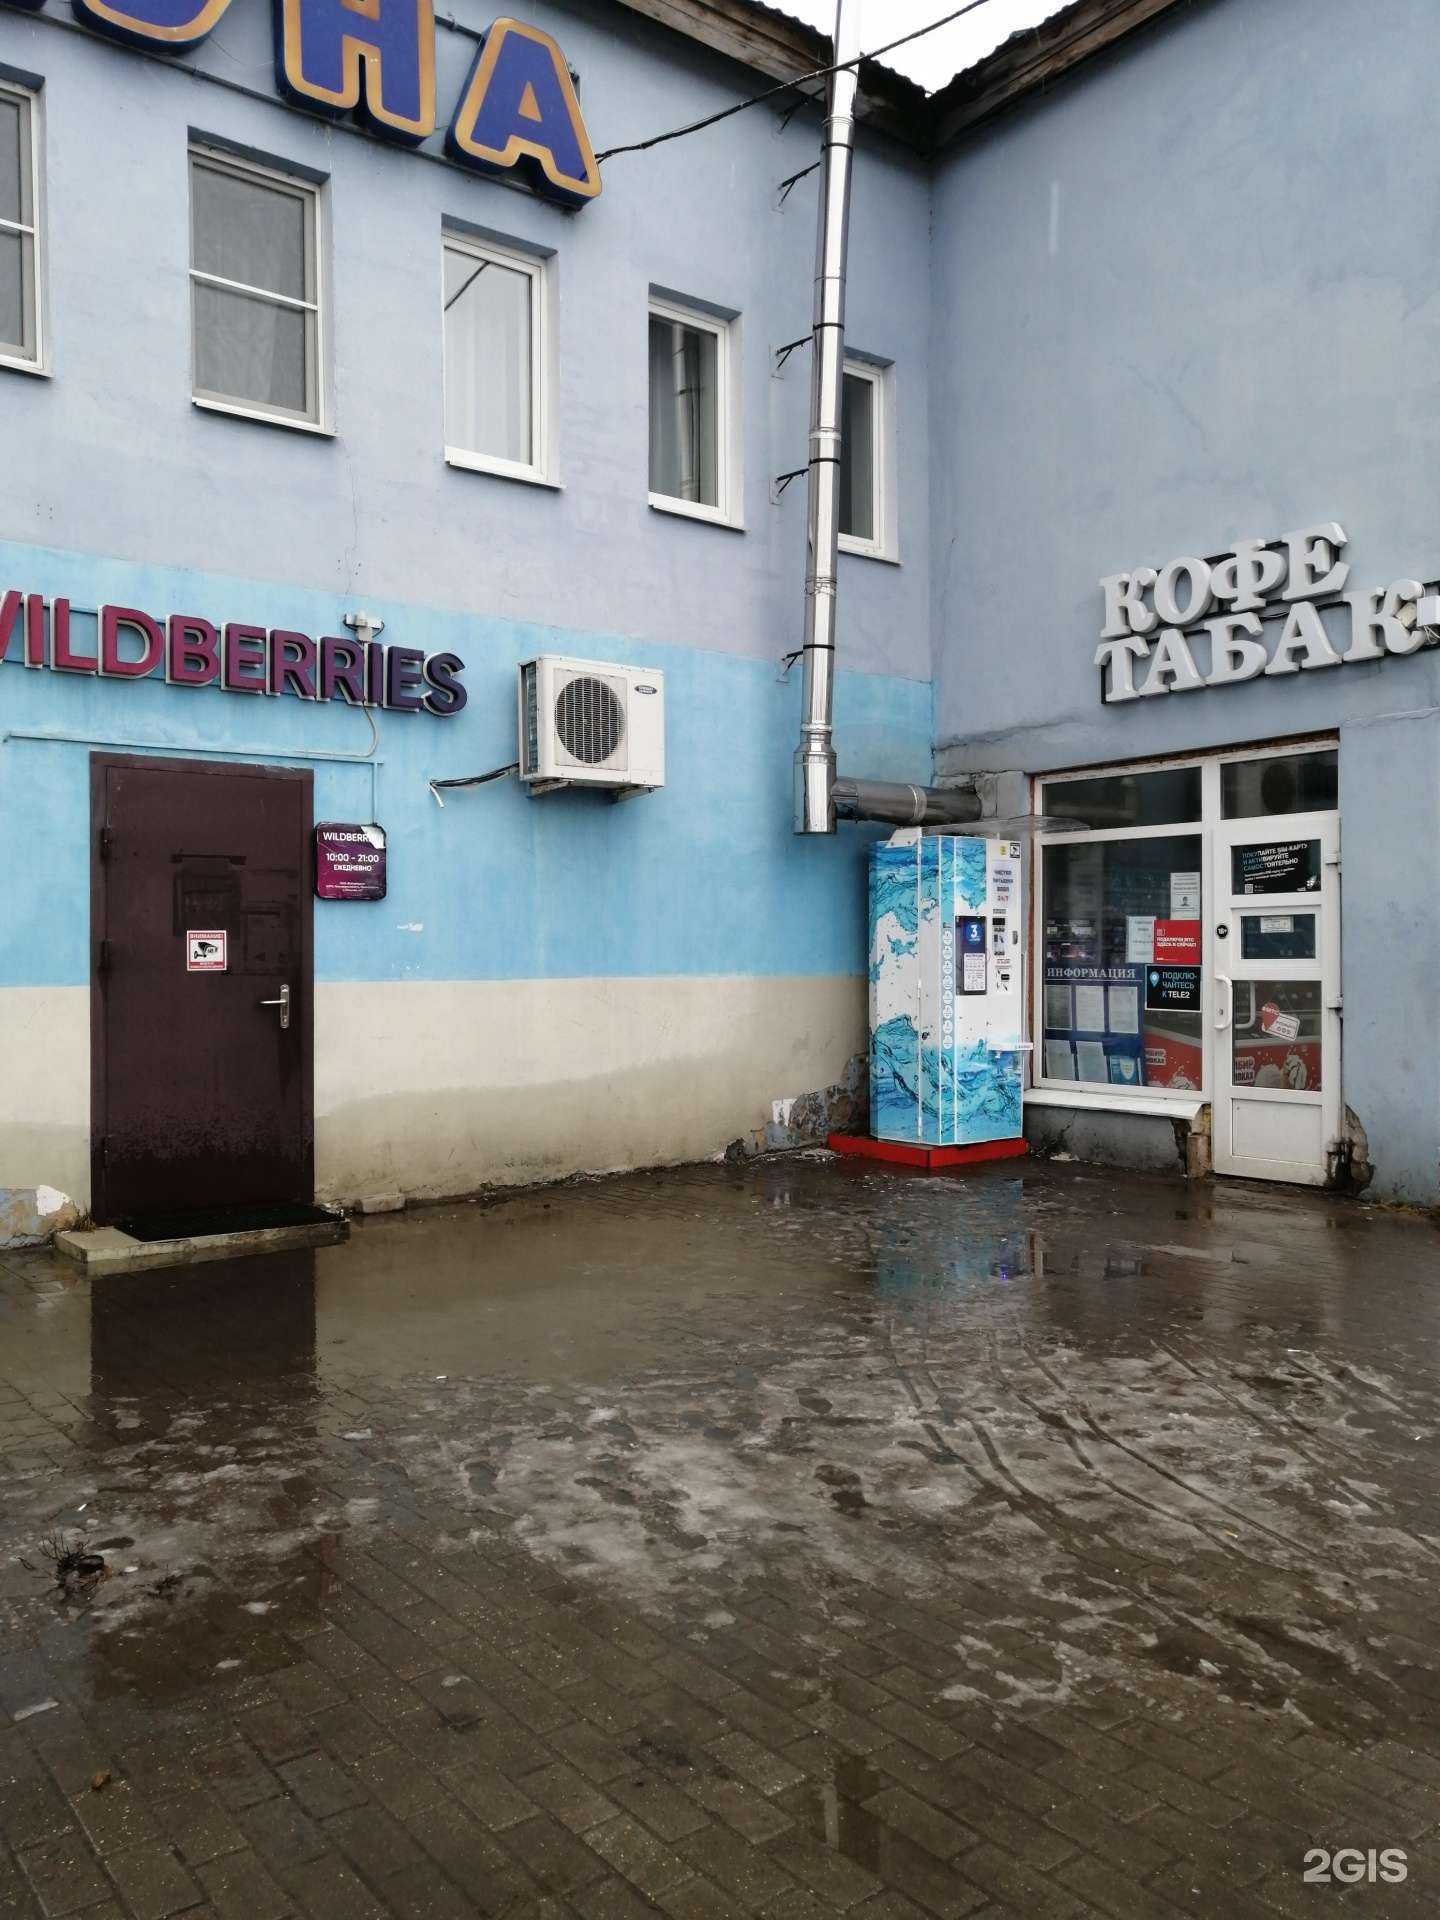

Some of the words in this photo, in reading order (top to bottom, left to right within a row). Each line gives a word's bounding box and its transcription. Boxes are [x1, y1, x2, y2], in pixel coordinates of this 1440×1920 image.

[1099, 521, 1350, 638] КОФЕ
[1094, 578, 1426, 702] ТАБАК
[326, 853, 349, 861] 10:00
[357, 854, 379, 862] 21:00
[333, 864, 372, 872] ЕЖЕДНЕВНО
[1046, 967, 1136, 979] ИНФОРМАЦИЯ
[1162, 971, 1197, 980] ПОДКЛЮ-
[1162, 980, 1195, 989] ЧАЙТЕСЬ
[1168, 990, 1190, 999] TELE2
